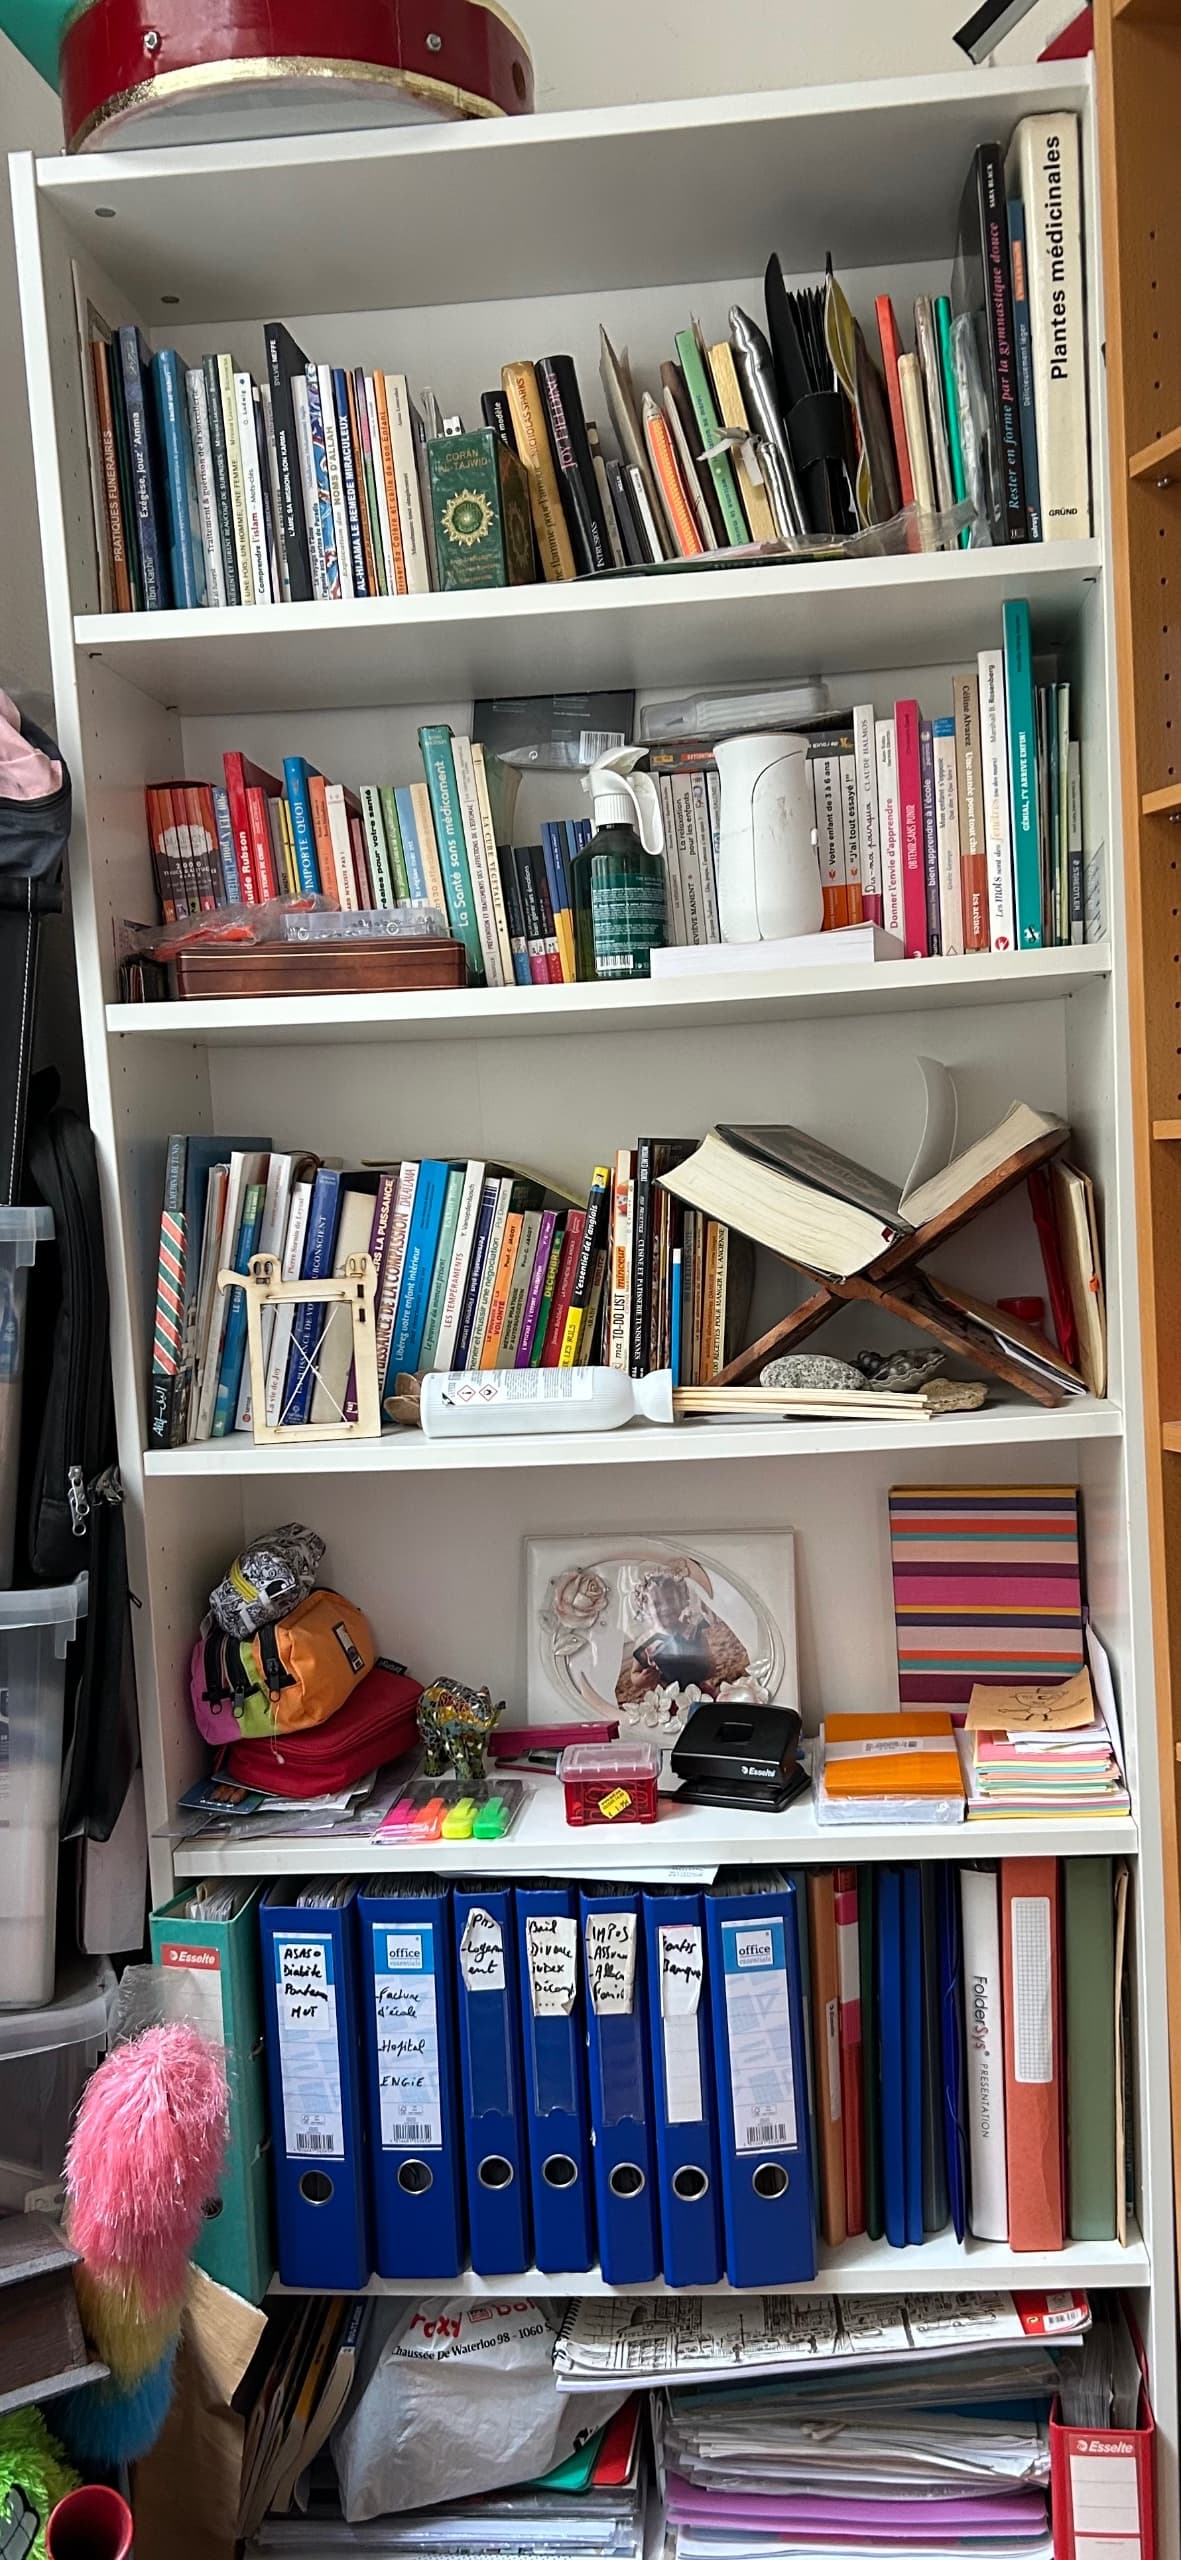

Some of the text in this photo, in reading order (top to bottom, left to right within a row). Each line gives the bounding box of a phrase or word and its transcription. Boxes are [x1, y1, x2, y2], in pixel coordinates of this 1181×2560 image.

[986, 163, 997, 209] SARA BLACK
[1041, 135, 1068, 381] Plantes médicinales
[270, 340, 278, 362] NEFFE
[987, 222, 1021, 510] Rester en forme par la gymnastique douce
[1020, 349, 1032, 407] Délicieusement
[494, 402, 507, 431] modèle
[197, 446, 205, 457] de
[279, 430, 289, 455] KARMA
[325, 426, 339, 473] D'ALLAH
[198, 459, 209, 496] guérison
[280, 456, 289, 472] SON
[103, 430, 123, 562] PRATIQUES FUNERAIRES
[332, 474, 341, 505] NOMS
[339, 415, 366, 590] AL-HIJAMA LE REMEDE MIRACULEUX
[204, 506, 214, 554] Traitement
[247, 467, 265, 594] Comprendre l'islam Mots-clés
[987, 664, 998, 704] Rosenberg
[961, 685, 973, 746] Céline Alvarez
[823, 761, 831, 776] ans
[965, 751, 973, 767] Une
[861, 757, 872, 791] CLAUDE
[966, 768, 974, 795] année
[364, 789, 376, 818] santé
[682, 792, 693, 823] enfants
[825, 801, 832, 812] de
[922, 779, 932, 809] l'école
[964, 797, 974, 817] pour
[293, 802, 305, 834] QUOI
[675, 798, 687, 851] La relaxation
[825, 813, 835, 840] enfant
[905, 804, 916, 824] PUNIR
[968, 818, 976, 837] tout
[369, 820, 379, 847] votre
[434, 761, 469, 927] La Santé sans médicament
[687, 837, 697, 856] pour
[907, 825, 916, 842] SANS
[924, 819, 936, 865] apprendre
[238, 831, 250, 873] Rubson
[373, 849, 385, 874] pour
[827, 842, 837, 866] Votre
[883, 798, 899, 929] Donner l'envie d'apprendre
[994, 844, 1002, 858] des
[926, 866, 936, 886] bien
[992, 876, 1003, 903] mots
[1073, 866, 1081, 911] STAEDTLER
[972, 893, 982, 935] les arènes
[995, 904, 1004, 918] Les
[375, 1179, 394, 1235] PUISSANCE
[373, 1236, 383, 1250] LA
[385, 1212, 409, 1284] COMPASSION
[574, 1204, 600, 1296] L'essentiel de l'anglais
[636, 1239, 645, 1265] CUISINE
[407, 1247, 421, 1281] intérieur
[483, 1237, 500, 1287] négociation
[637, 1267, 644, 1275] ET
[383, 1286, 397, 1299] LA
[404, 1282, 417, 1308] enfant
[444, 1253, 464, 1328] LES TEMPÉRAMENTS
[480, 1288, 489, 1304] une
[612, 1247, 626, 1359] ma TO-DO LIST minceur
[381, 1302, 395, 1315] DE
[400, 1311, 411, 1331] votre
[474, 1306, 487, 1335] réussir
[395, 1333, 409, 1361] Libérez
[473, 1336, 481, 1345] et
[266, 1368, 281, 1414] La vie de Joy
[178, 1950, 216, 1965] Esselte
[389, 1948, 421, 1960] office
[738, 1944, 770, 1956] office
[979, 2063, 991, 2138] PRESENTATION
[409, 2311, 462, 2338] roxy
[391, 2345, 434, 2360] Chaussée
[451, 2338, 496, 2356] Waterloo
[497, 2332, 510, 2344] 98
[519, 2325, 544, 2339] 1060
[1089, 2441, 1133, 2453] Esselte
